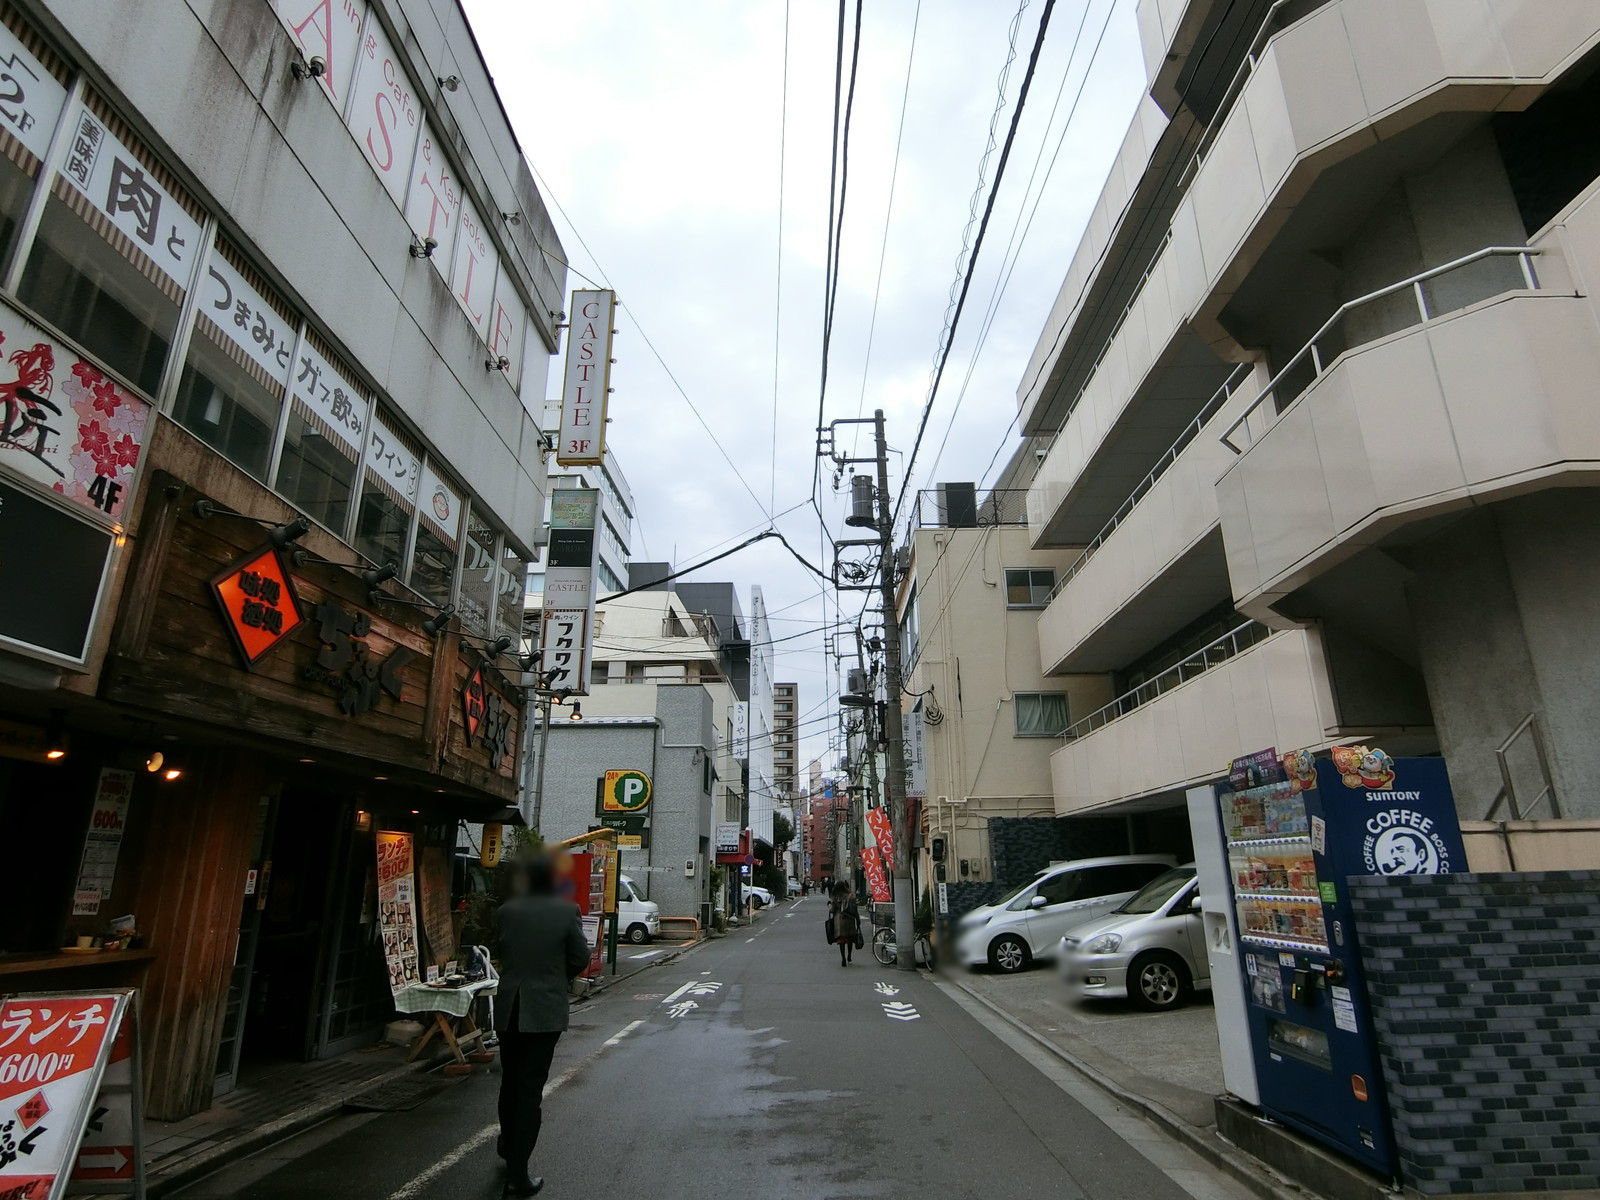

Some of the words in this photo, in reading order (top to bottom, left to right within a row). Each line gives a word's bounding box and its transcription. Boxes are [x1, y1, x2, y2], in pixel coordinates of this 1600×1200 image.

[68, 117, 101, 184] 美味肉
[105, 155, 186, 263] 肉と
[208, 265, 290, 370] つまみと
[571, 302, 600, 427] CASTLE
[371, 431, 407, 478] ワイン
[568, 439, 592, 454] 3F
[87, 474, 123, 514] 4F
[548, 584, 588, 592] CASTLE
[555, 622, 574, 682] フクワケ
[623, 778, 644, 804] P
[1365, 790, 1421, 801] SUNTORY
[1366, 809, 1434, 834] COFFEE
[377, 836, 406, 862] ランチ
[1363, 835, 1376, 872] COFFEE
[1430, 833, 1448, 858] BOSS
[1440, 860, 1450, 875] CO
[0, 1004, 106, 1048] ランチ
[0, 1119, 48, 1170] ょっぷく
